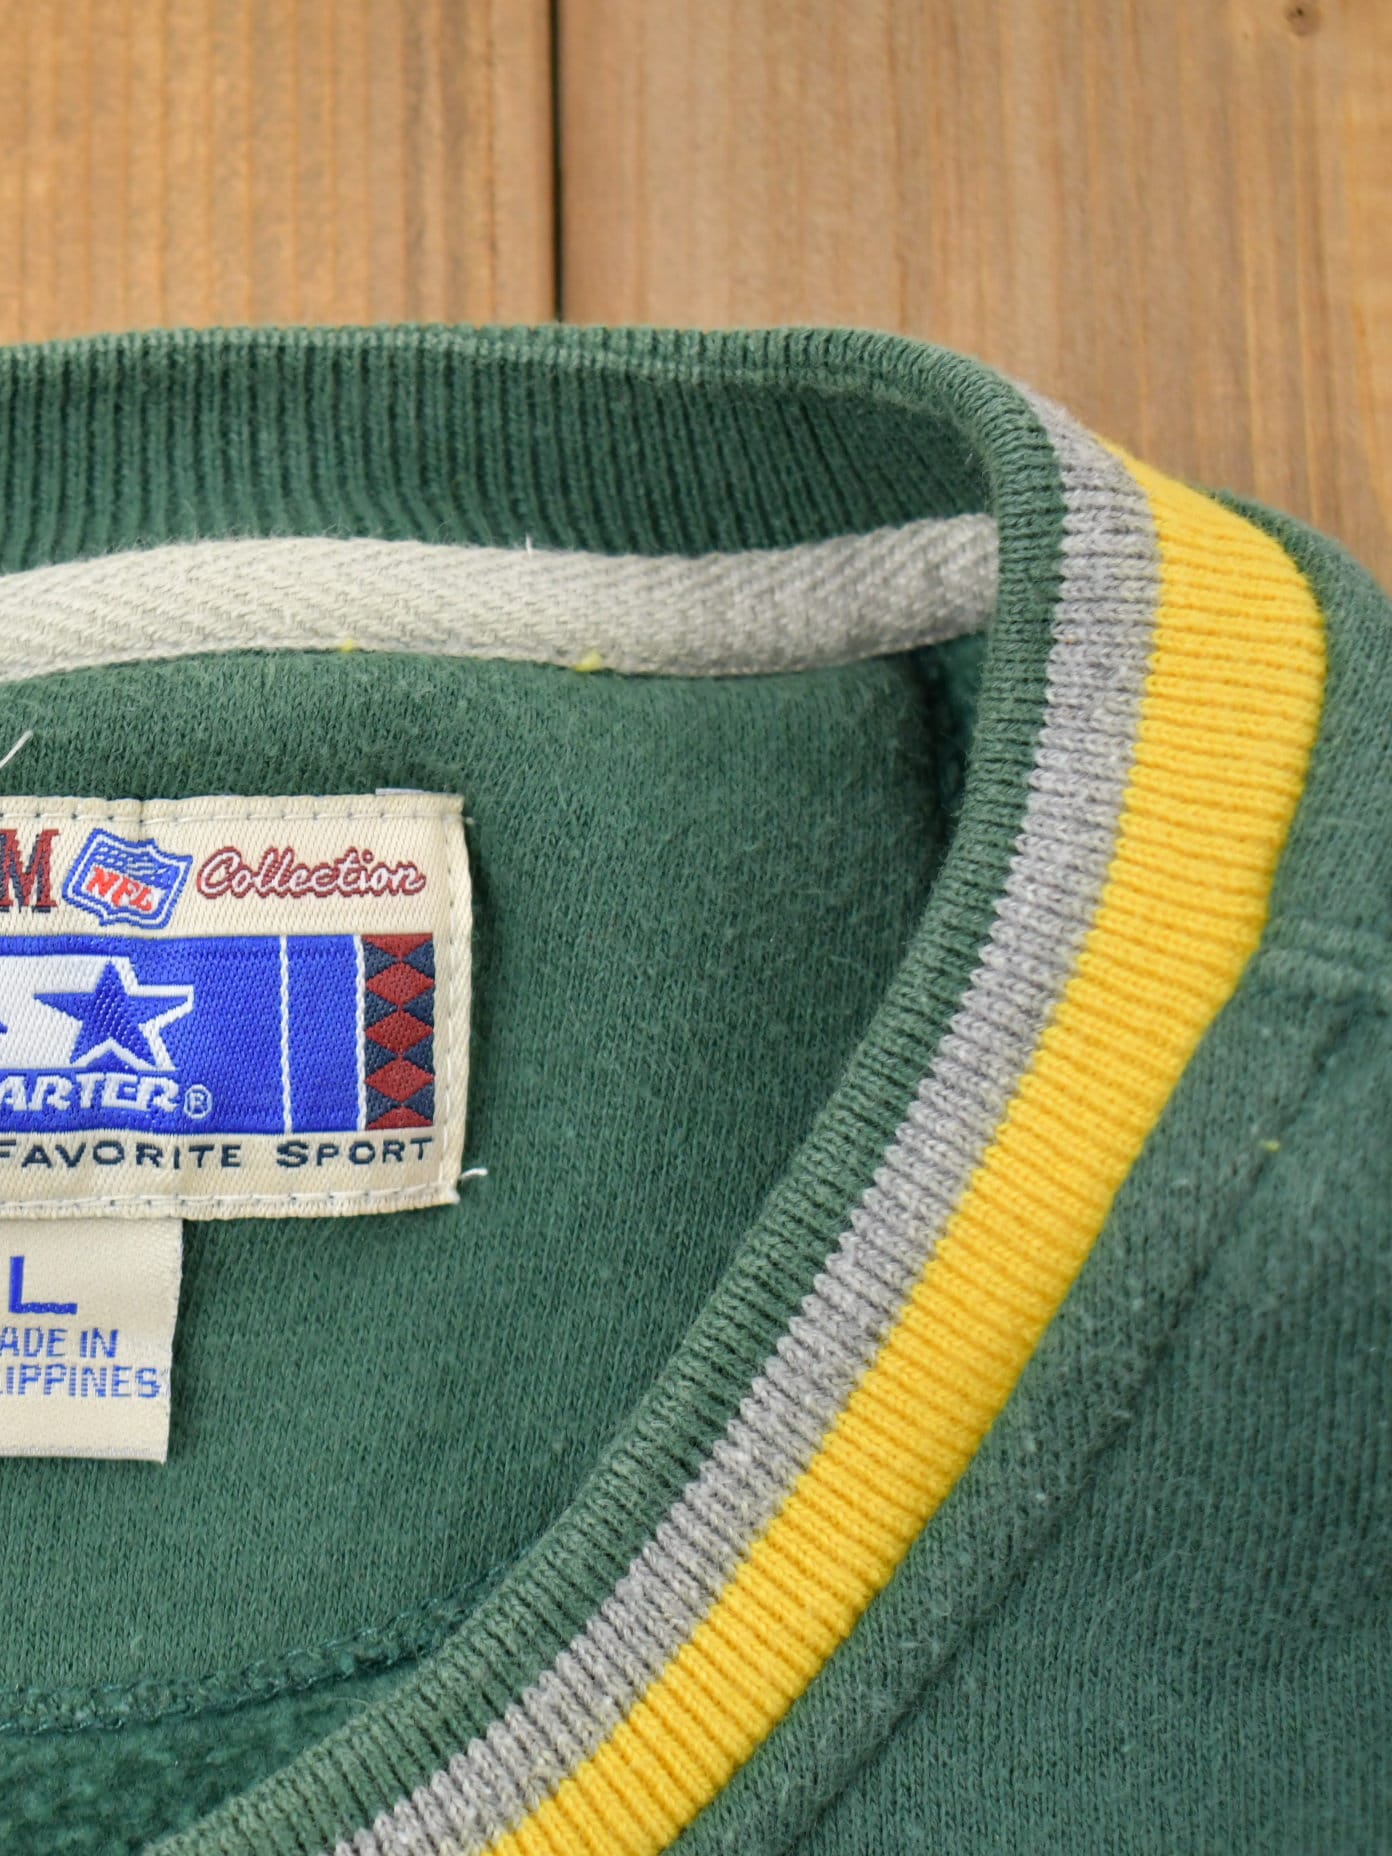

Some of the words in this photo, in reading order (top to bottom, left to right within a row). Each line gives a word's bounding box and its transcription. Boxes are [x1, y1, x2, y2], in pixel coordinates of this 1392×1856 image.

[83, 864, 155, 913] NFL
[197, 845, 426, 898] Collection
[276, 1137, 433, 1168] SPORT
[8, 1255, 78, 1315] L
[79, 1327, 119, 1358] IN
